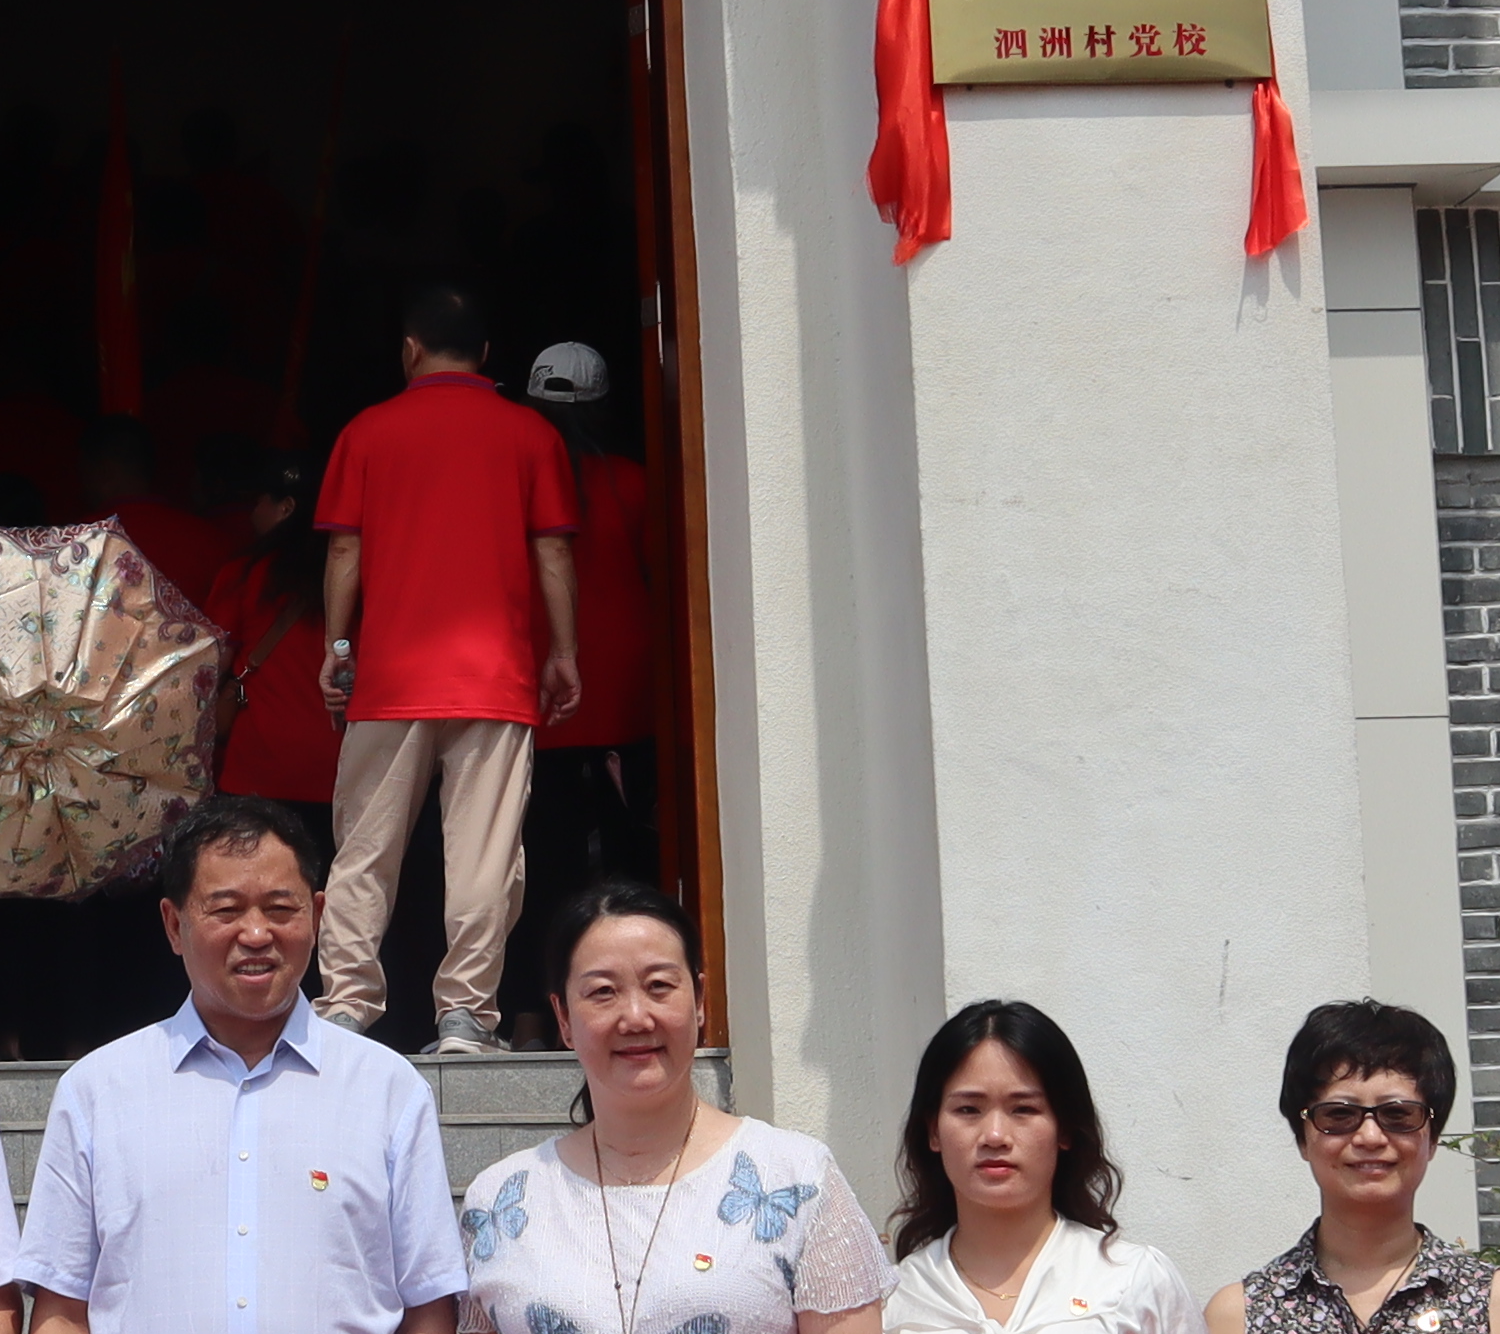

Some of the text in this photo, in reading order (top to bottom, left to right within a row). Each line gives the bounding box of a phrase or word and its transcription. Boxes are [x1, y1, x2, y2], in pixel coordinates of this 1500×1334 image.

[994, 22, 1208, 59] 泗洲村党校
